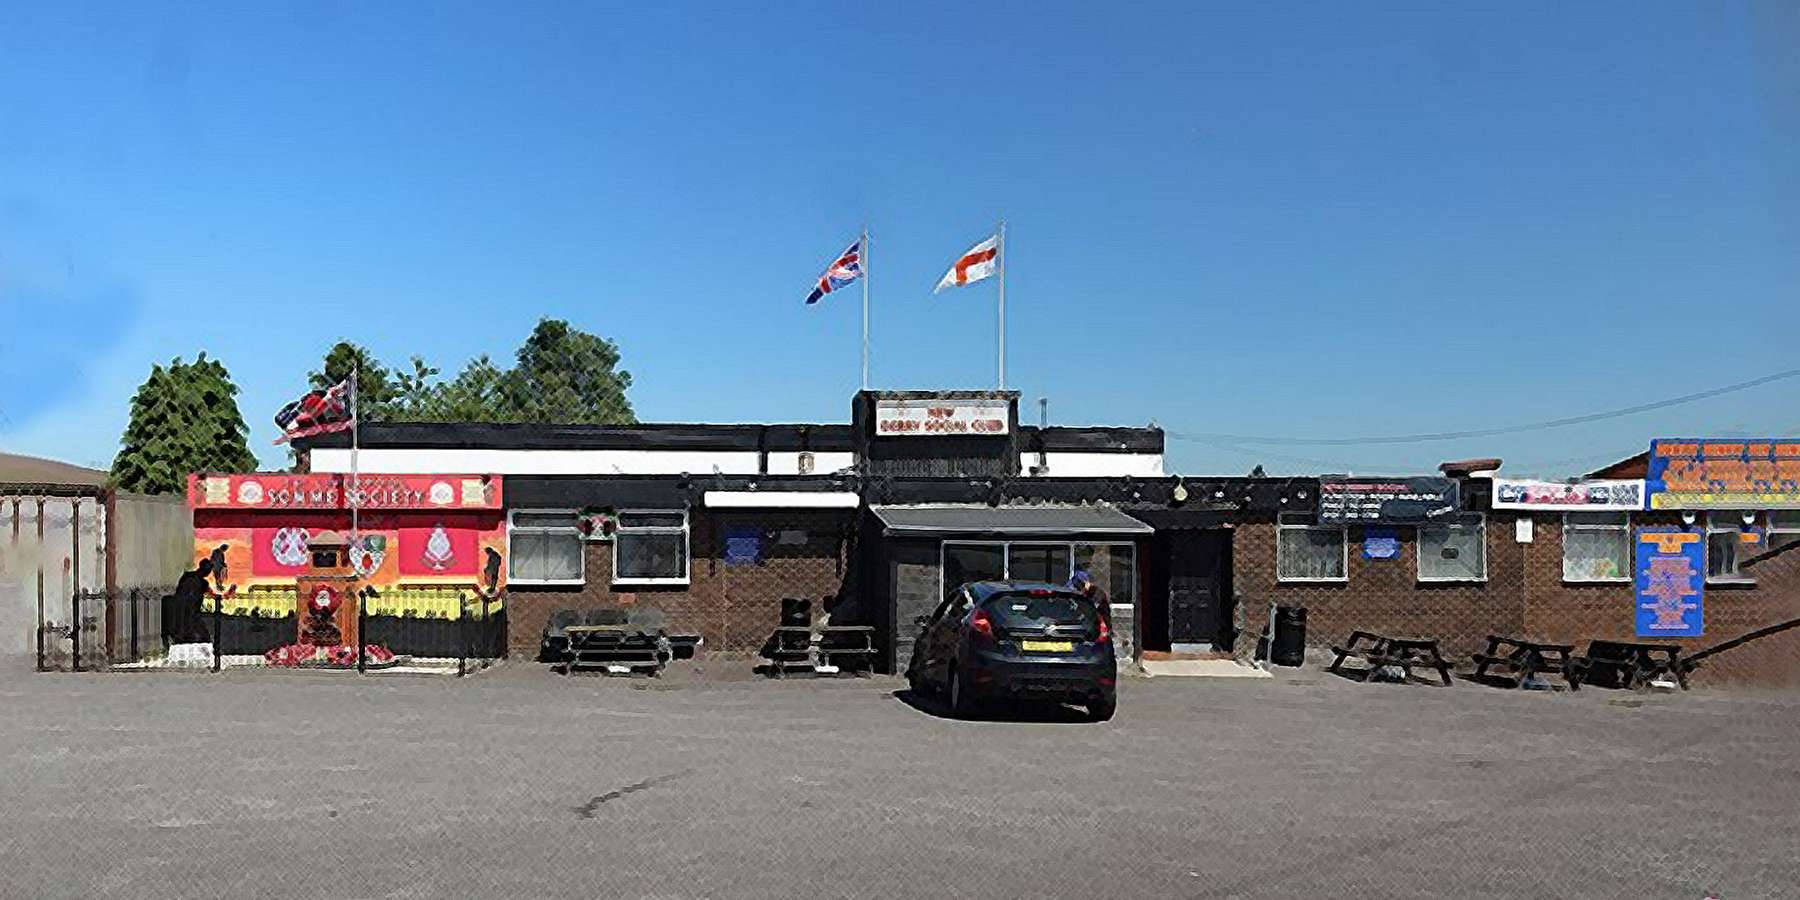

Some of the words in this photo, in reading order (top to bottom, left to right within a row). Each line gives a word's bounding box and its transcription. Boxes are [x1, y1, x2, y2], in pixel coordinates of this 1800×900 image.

[924, 419, 968, 432] SOCIAL
[267, 488, 339, 505] SOMME
[344, 488, 426, 505] SOCIETY
